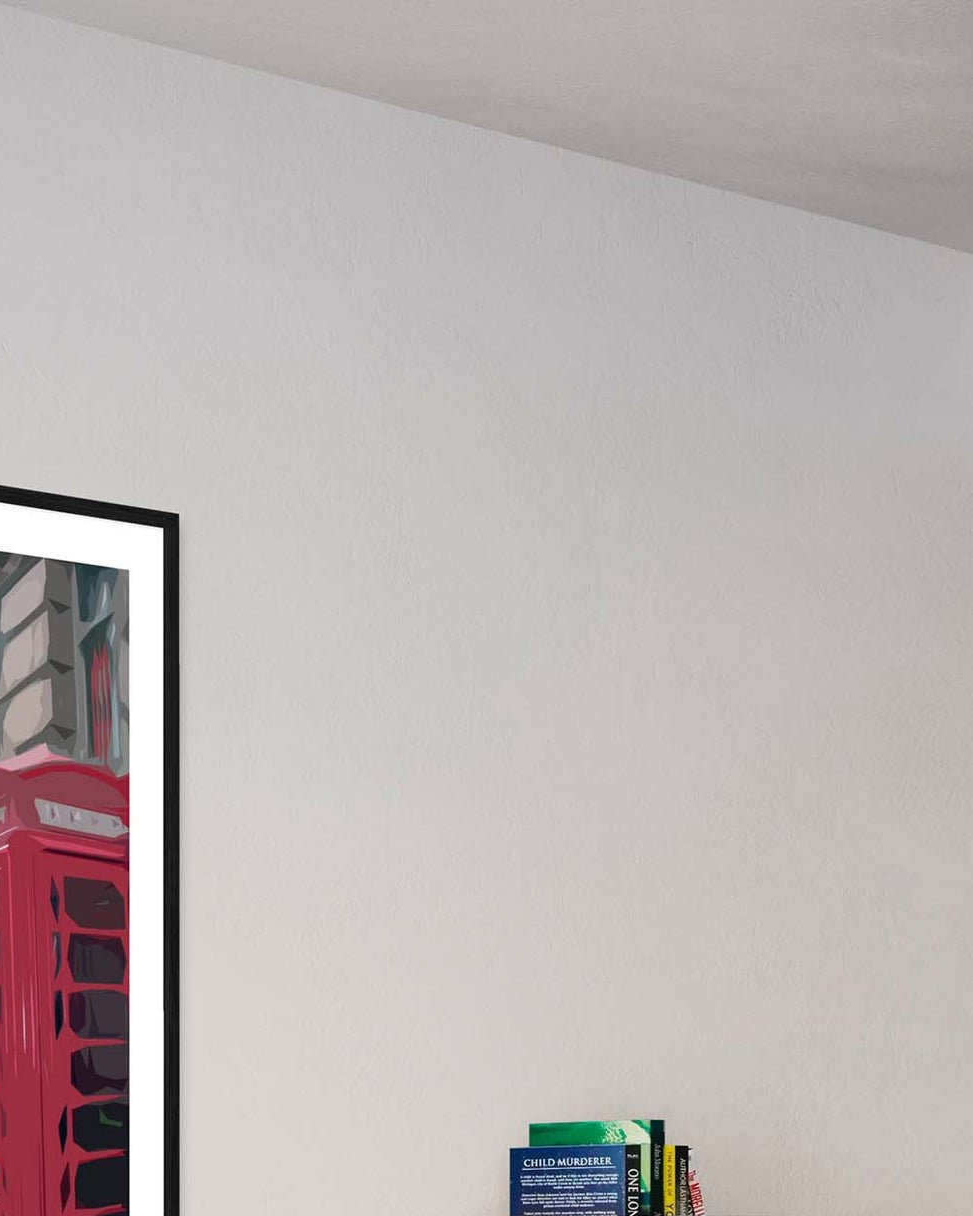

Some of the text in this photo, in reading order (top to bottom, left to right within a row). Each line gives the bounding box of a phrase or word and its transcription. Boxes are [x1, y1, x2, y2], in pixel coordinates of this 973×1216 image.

[523, 1156, 612, 1168] CHILD MURDERER
[627, 1168, 639, 1192] ONE
